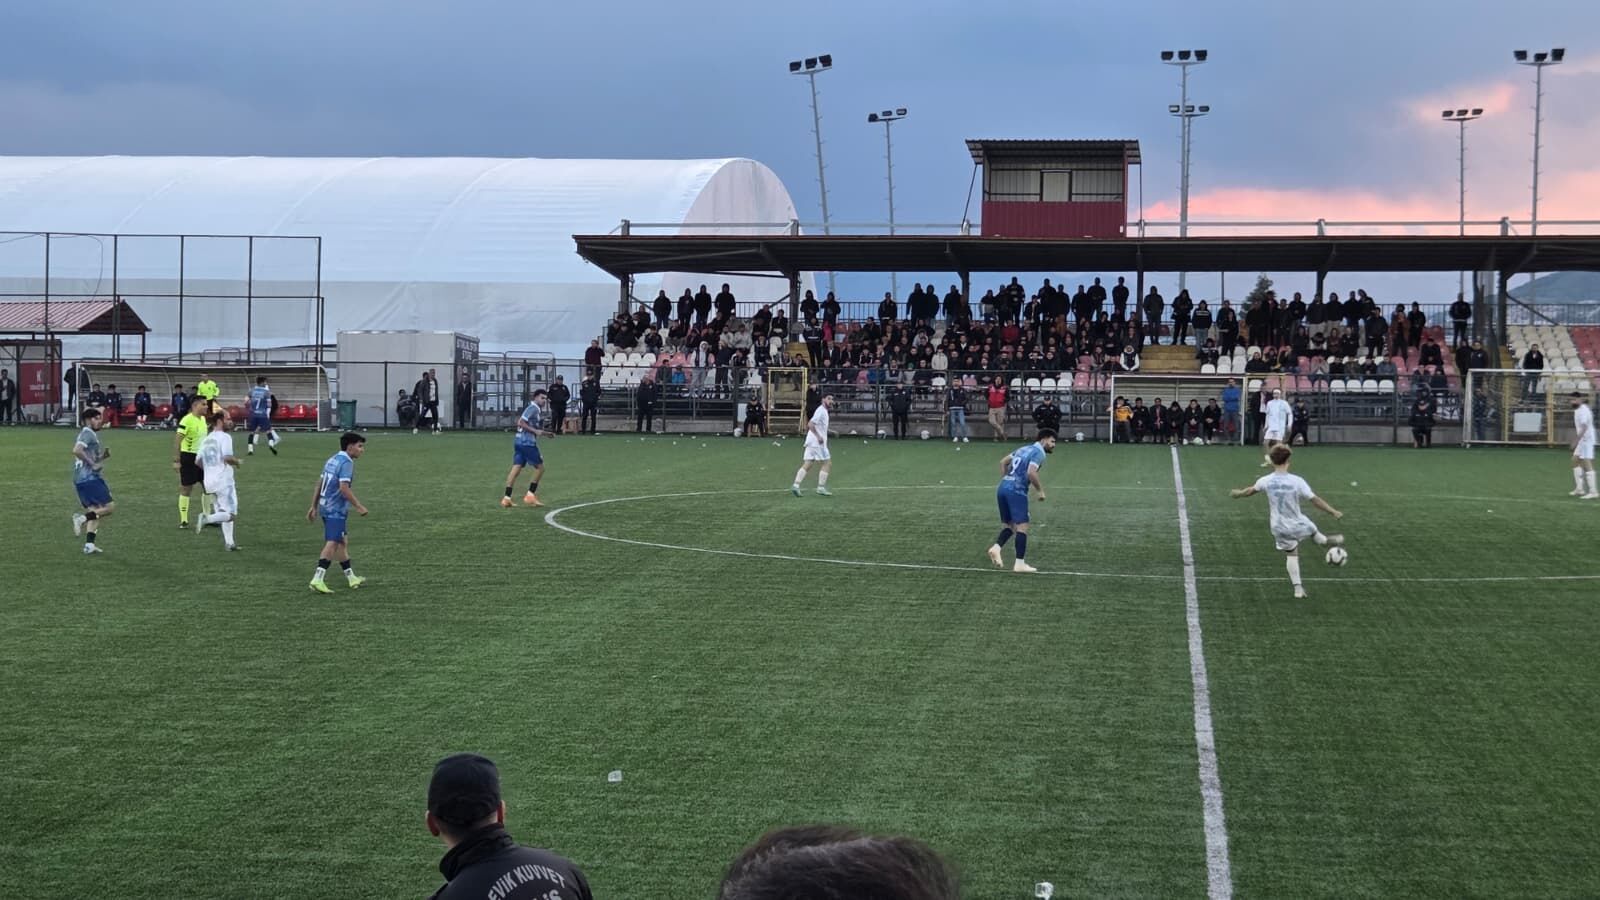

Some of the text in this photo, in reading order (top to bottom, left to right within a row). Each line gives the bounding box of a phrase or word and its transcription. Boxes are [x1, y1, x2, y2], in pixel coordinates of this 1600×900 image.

[255, 397, 261, 410] 7
[1010, 456, 1022, 476] 9
[320, 471, 335, 497] 17
[513, 864, 566, 889] KUVVET
